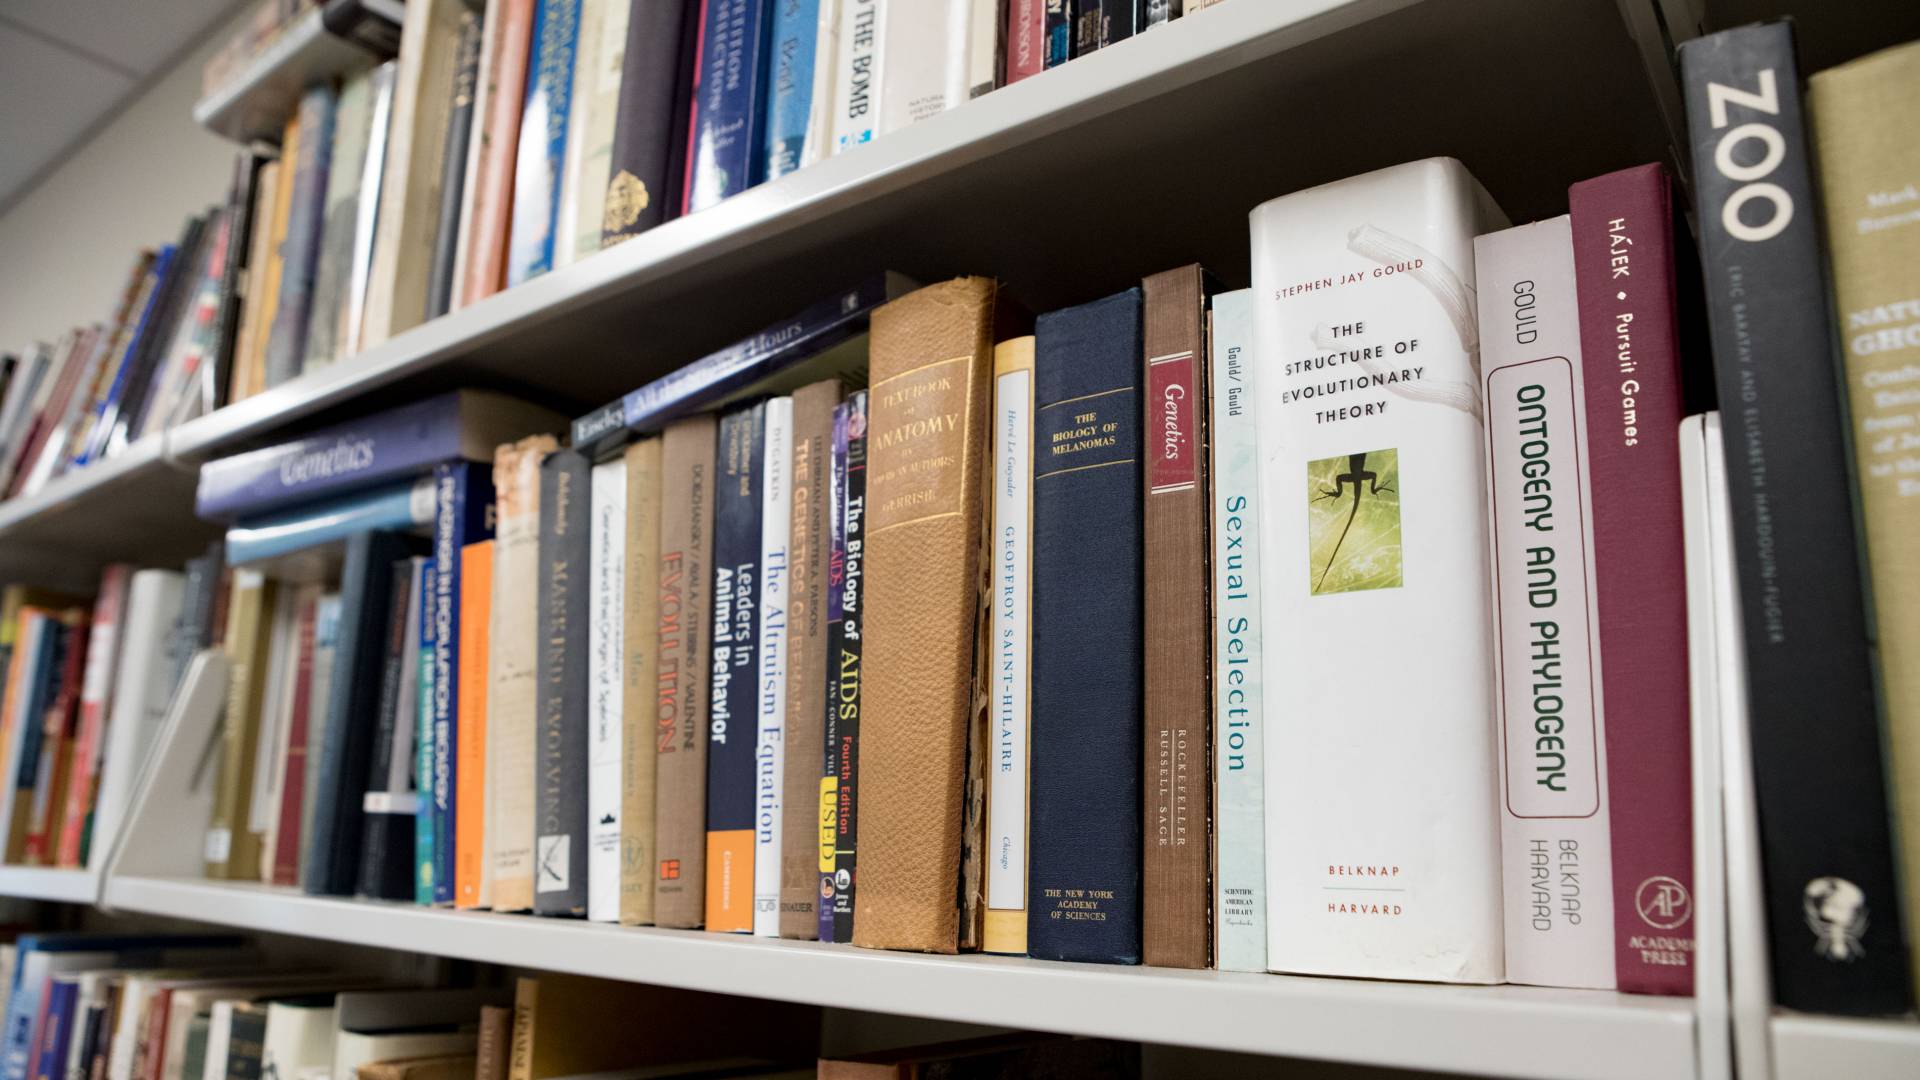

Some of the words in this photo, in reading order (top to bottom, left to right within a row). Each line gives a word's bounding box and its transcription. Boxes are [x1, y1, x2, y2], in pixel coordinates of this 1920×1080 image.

[853, 4, 876, 52] THE
[849, 54, 873, 119] BOMB
[1707, 68, 1794, 242] ZOO
[1608, 218, 1633, 279] HÁJEK
[1275, 278, 1332, 300] STEPHEN
[1340, 272, 1364, 285] JAY
[1373, 259, 1423, 278] GOULD
[1331, 322, 1364, 339] THE
[1513, 280, 1537, 344] GOULD
[748, 322, 803, 358] Hours
[1285, 345, 1383, 376] STRUCTURE
[1394, 339, 1418, 354] OF
[1616, 312, 1638, 373] Pursuit
[1228, 387, 1242, 416] Gould
[1282, 367, 1423, 404] EVOLUTIONARY
[1741, 370, 1757, 402] AND
[876, 413, 958, 450] ANATOMY
[1052, 426, 1098, 443] BIOLOGY
[1102, 422, 1118, 433] OF
[1075, 412, 1097, 424] THE
[1164, 383, 1186, 460] Genetics
[1316, 401, 1386, 424] THEORY
[1620, 379, 1640, 447] Games
[280, 436, 376, 486] Genetics
[795, 439, 809, 484] THE
[1007, 441, 1016, 453] Le
[1052, 435, 1116, 455] MELANOMAS
[1516, 384, 1554, 531] ONTOGENY
[740, 476, 751, 497] and
[1005, 457, 1016, 498] Guyader
[847, 495, 863, 533] The
[793, 487, 808, 594] GENETICS
[1226, 495, 1248, 601] Sexual
[767, 546, 786, 593] The
[830, 549, 843, 587] AIDS
[842, 539, 861, 612] Biology
[1003, 526, 1015, 621] GEOFFROY
[1526, 546, 1557, 608] AND
[550, 560, 569, 683] MANKIND
[715, 568, 734, 643] Animal
[736, 563, 754, 642] Leaders
[792, 601, 805, 632] OF
[657, 551, 684, 754] EVOLUTION
[844, 620, 859, 641] of
[435, 595, 452, 719] POPULATION
[734, 645, 752, 666] in
[763, 604, 785, 715] Altruism
[711, 646, 731, 744] Behavior
[828, 680, 838, 699] FAN
[840, 648, 859, 720] AIDS
[1001, 630, 1014, 772] SAINT-HILAIRE
[1228, 617, 1250, 771] Selection
[1530, 620, 1567, 792] PHYLOGENY
[684, 683, 696, 752] VALENTINE
[828, 706, 837, 746] CONNER
[434, 720, 450, 811] BIOLOGY
[544, 697, 563, 833] EVOLVING
[841, 735, 852, 780] Fourth
[1159, 730, 1169, 796] RUSSELL
[756, 726, 781, 844] Equation
[1176, 729, 1187, 846] ROCKEFELLER
[822, 789, 836, 861] USED
[840, 786, 851, 834] Edition
[1159, 806, 1168, 846] SAGE
[999, 836, 1011, 870] Chicago
[1328, 865, 1399, 876] BELKNAP
[1044, 889, 1061, 897] THE
[1065, 889, 1084, 898] NEW
[1088, 890, 1114, 899] YORK
[1057, 900, 1098, 909] ACADEMY
[1530, 839, 1551, 931] HARVARD
[1559, 839, 1582, 925] BELKNAP
[1051, 911, 1062, 919] OF
[1065, 911, 1106, 921] SCIENCES
[1328, 903, 1401, 915] HARVARD
[1640, 950, 1687, 966] PRESS
